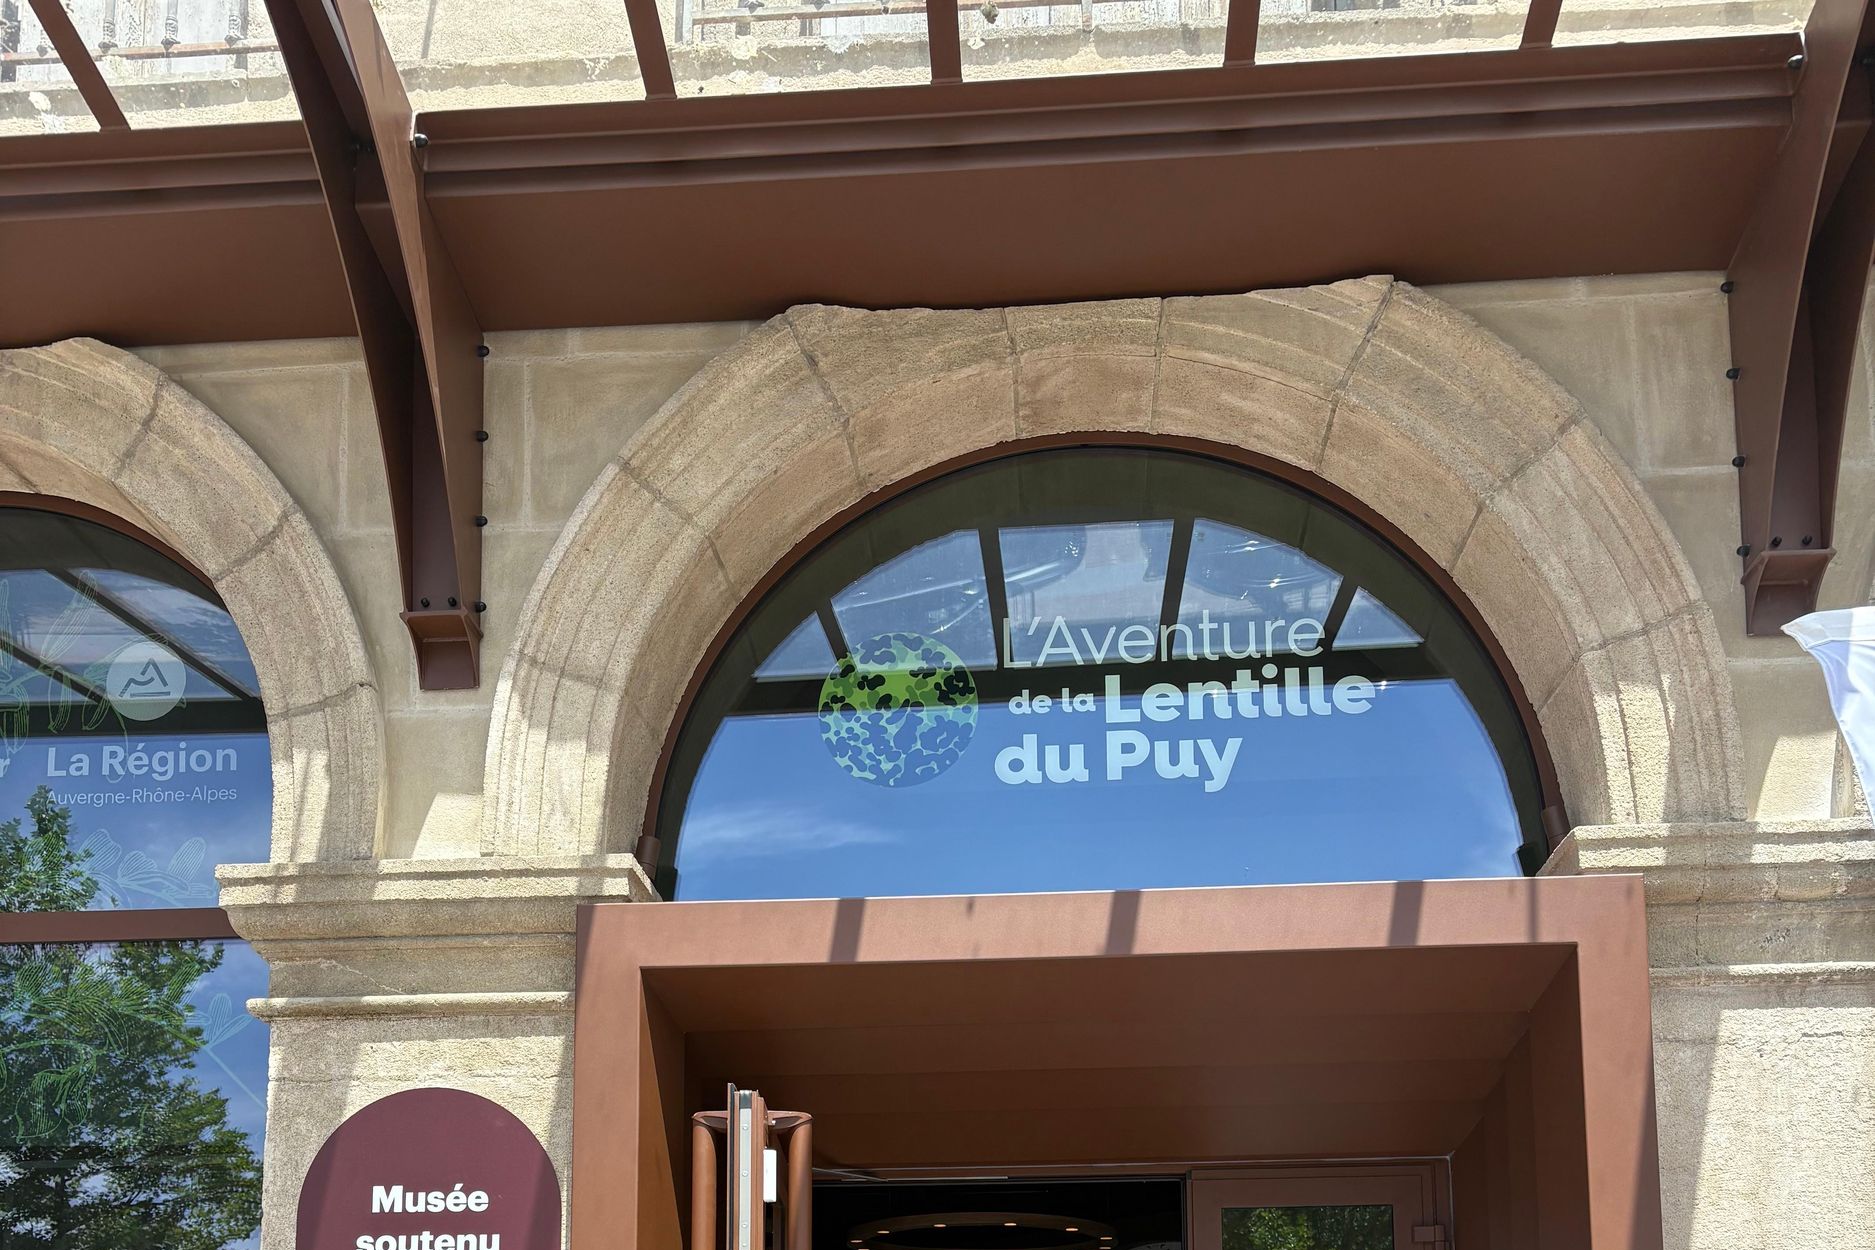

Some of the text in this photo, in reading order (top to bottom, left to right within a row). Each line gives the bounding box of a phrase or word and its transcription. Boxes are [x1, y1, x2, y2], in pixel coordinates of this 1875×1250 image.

[1008, 664, 1376, 724] de la Lentille
[47, 747, 90, 777] La
[102, 741, 237, 781] Région
[994, 730, 1243, 793] du Puy
[47, 785, 237, 807] Auvergne-Rhône-Alpes
[371, 1183, 489, 1213] Musée
